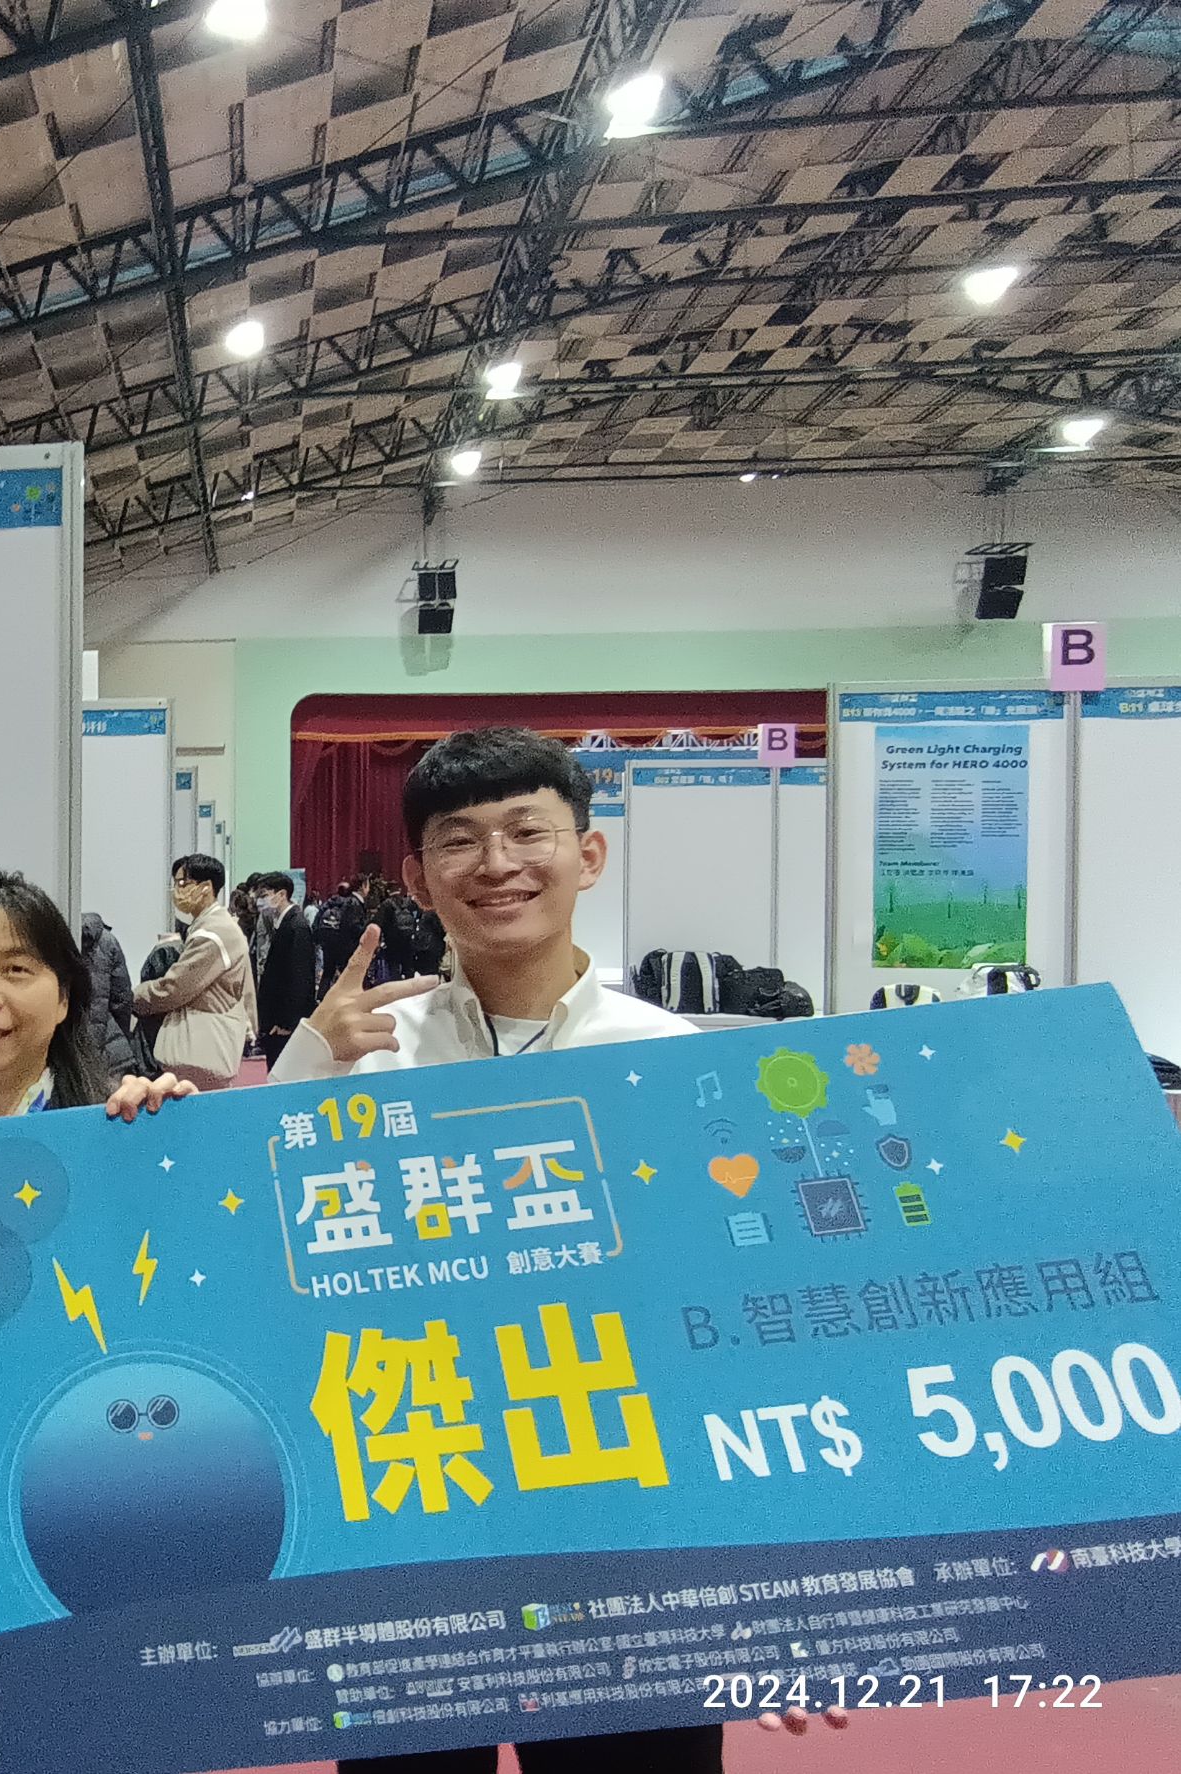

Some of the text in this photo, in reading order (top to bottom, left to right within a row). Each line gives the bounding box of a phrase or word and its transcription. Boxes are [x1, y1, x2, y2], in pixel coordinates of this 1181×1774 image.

[1061, 629, 1095, 666] B
[768, 727, 789, 751] B
[885, 744, 1023, 756] Green Light Charging
[881, 760, 1028, 771] System for HERO 4000
[279, 1093, 418, 1150] 第19屆
[295, 1140, 594, 1254] 盛群盃
[311, 1241, 603, 1298] HOLTEK MCU 創意大賽
[310, 1302, 1181, 1522] 傑出 NT$ 5,000
[739, 1578, 800, 1602] STEAM
